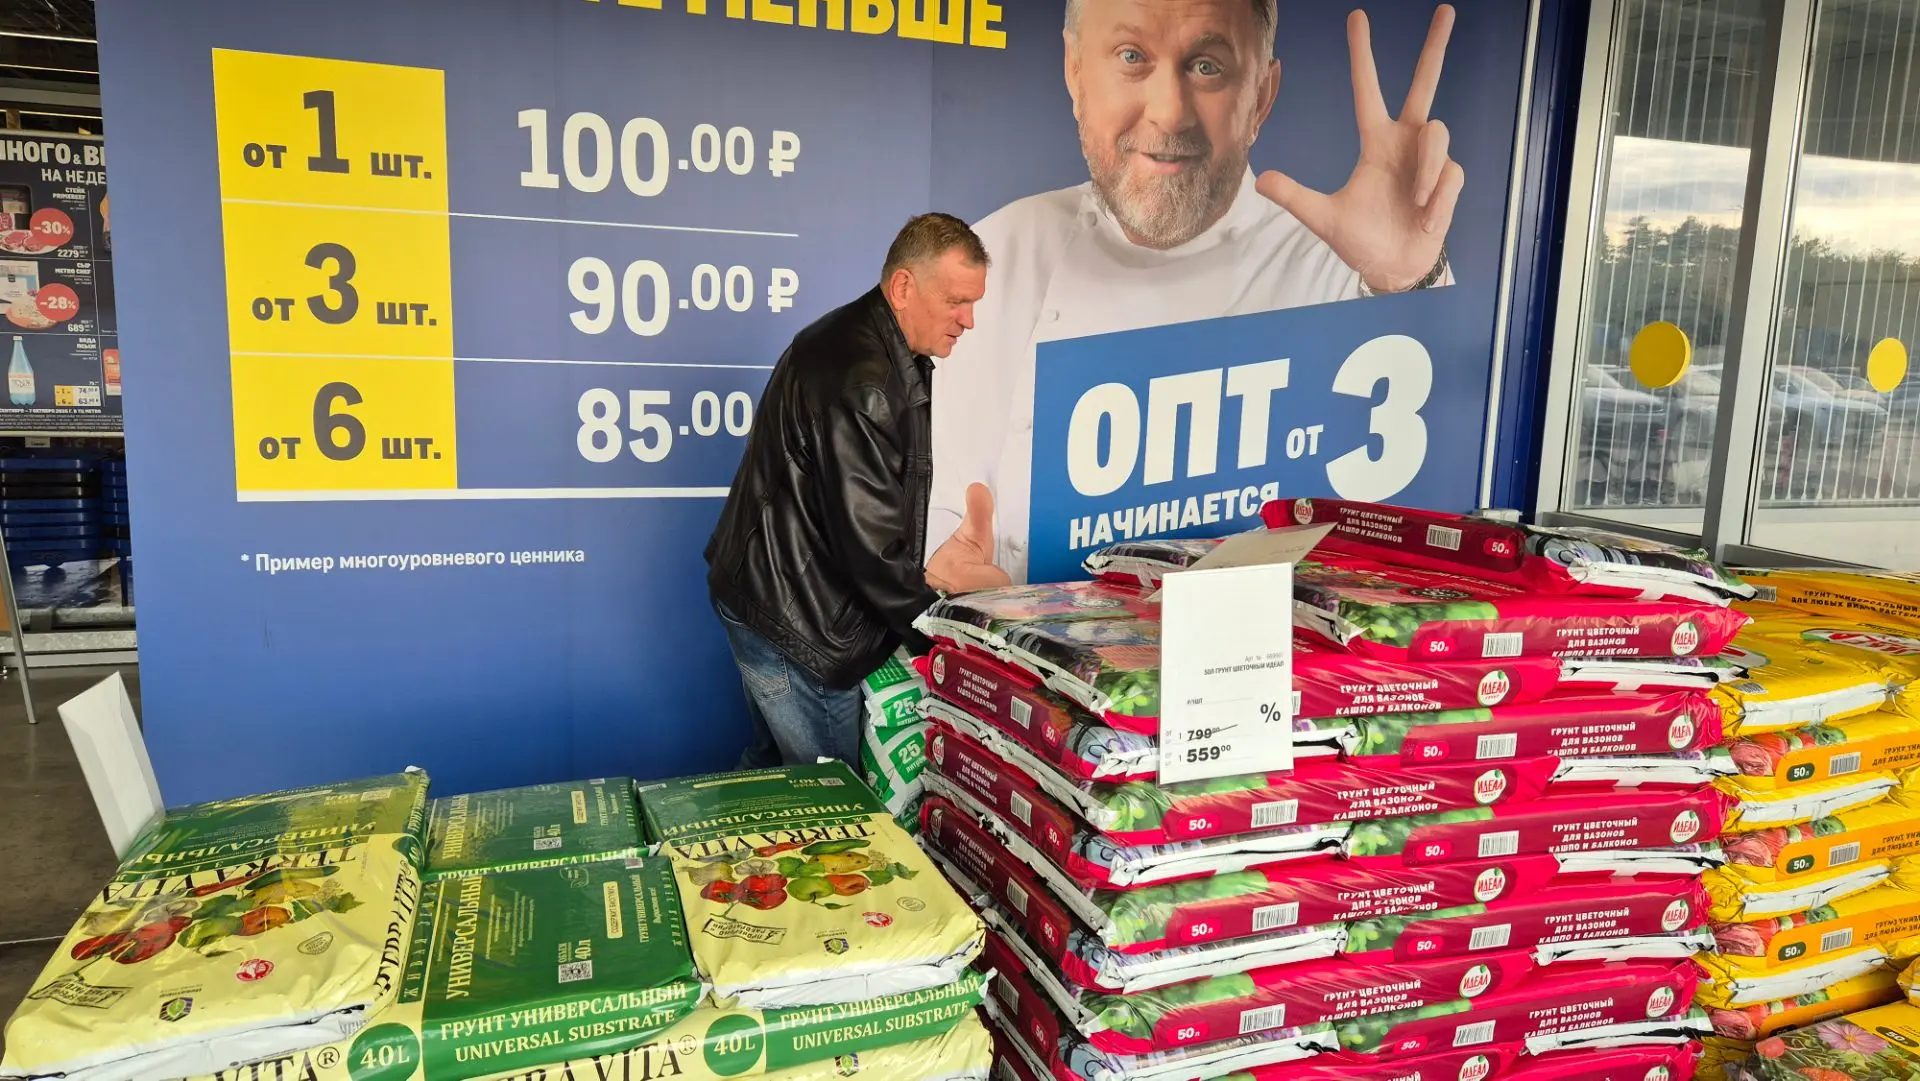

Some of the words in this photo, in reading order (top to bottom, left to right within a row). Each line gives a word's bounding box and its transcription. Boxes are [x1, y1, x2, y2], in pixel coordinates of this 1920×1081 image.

[687, 0, 1007, 49] ЬШЕ
[303, 89, 349, 175] 1
[41, 168, 63, 182] НА
[304, 242, 360, 324] 3
[312, 381, 367, 461] 6
[1066, 357, 1291, 498] ОПТ
[1325, 334, 1433, 504] 3
[1069, 482, 1280, 551] НАЧИНАЕТСЯ
[1339, 507, 1360, 517] ГРУНТ
[1346, 517, 1359, 525] ДЛЯ
[255, 550, 335, 573] Пример
[339, 548, 505, 571] многоуровневого
[509, 546, 585, 566] ценника
[1556, 628, 1584, 637] ГРУНТ
[1567, 638, 1585, 648] ДЛЯ
[1340, 684, 1372, 694] ГРУНТ
[1352, 694, 1374, 704] ДЛЯ
[1259, 702, 1282, 724] %
[1551, 726, 1580, 736] ГРУНТ
[1561, 737, 1580, 747] ДЛЯ
[898, 740, 921, 765] 25
[1337, 788, 1369, 800] ГРУНТ
[1349, 800, 1371, 809] ДЛЯ
[1553, 822, 1581, 832] ГРУНТ
[760, 823, 876, 846] TERRA
[1562, 833, 1581, 842] ДЛЯ
[1545, 914, 1573, 925] ГРУНТ
[1554, 924, 1574, 934] ДЛЯ
[1323, 990, 1355, 1002] ГРУНТ
[780, 1004, 835, 1031] ГРУНТ
[837, 975, 979, 1020] УНИВЕРСАЛЬНЫЙ
[1336, 1000, 1357, 1011] ДЛЯ
[441, 1013, 506, 1041] ГРУНТ
[511, 982, 687, 1022] УНИВЕРСАЛЬНЫЙ
[1529, 1009, 1557, 1019] ГРУНТ
[792, 1019, 881, 1051] UNIVERSAL
[885, 1001, 970, 1033] SUBSTRATE
[1539, 1018, 1558, 1027] ДЛЯ
[455, 1026, 564, 1062] UNIVERSAL
[568, 1008, 675, 1042] SUBSTRATE
